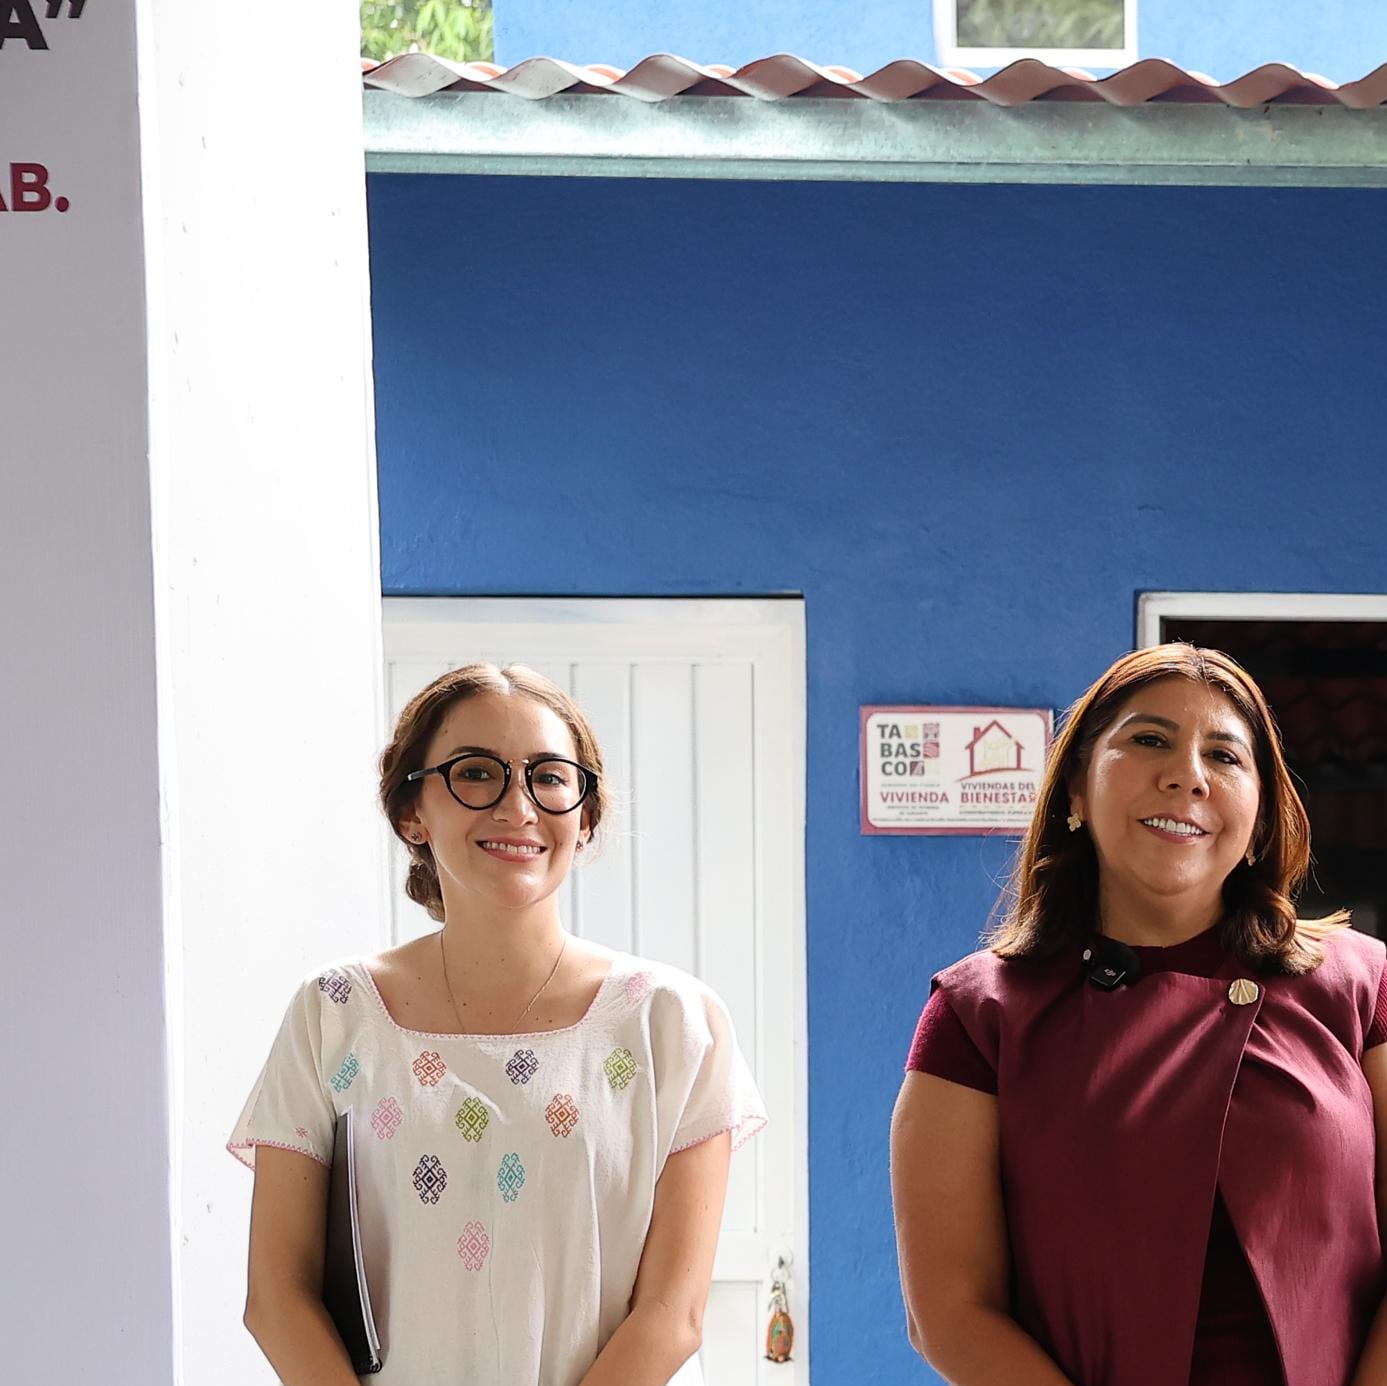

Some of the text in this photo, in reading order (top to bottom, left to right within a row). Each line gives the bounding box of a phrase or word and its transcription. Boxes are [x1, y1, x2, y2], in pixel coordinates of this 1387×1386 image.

[0, 163, 69, 213] B.
[877, 724, 901, 739] TA
[881, 743, 921, 758] BAS
[881, 761, 907, 776] CO
[961, 782, 1036, 790] VIVIENDAS DEL
[880, 791, 949, 803] VIVIENDA
